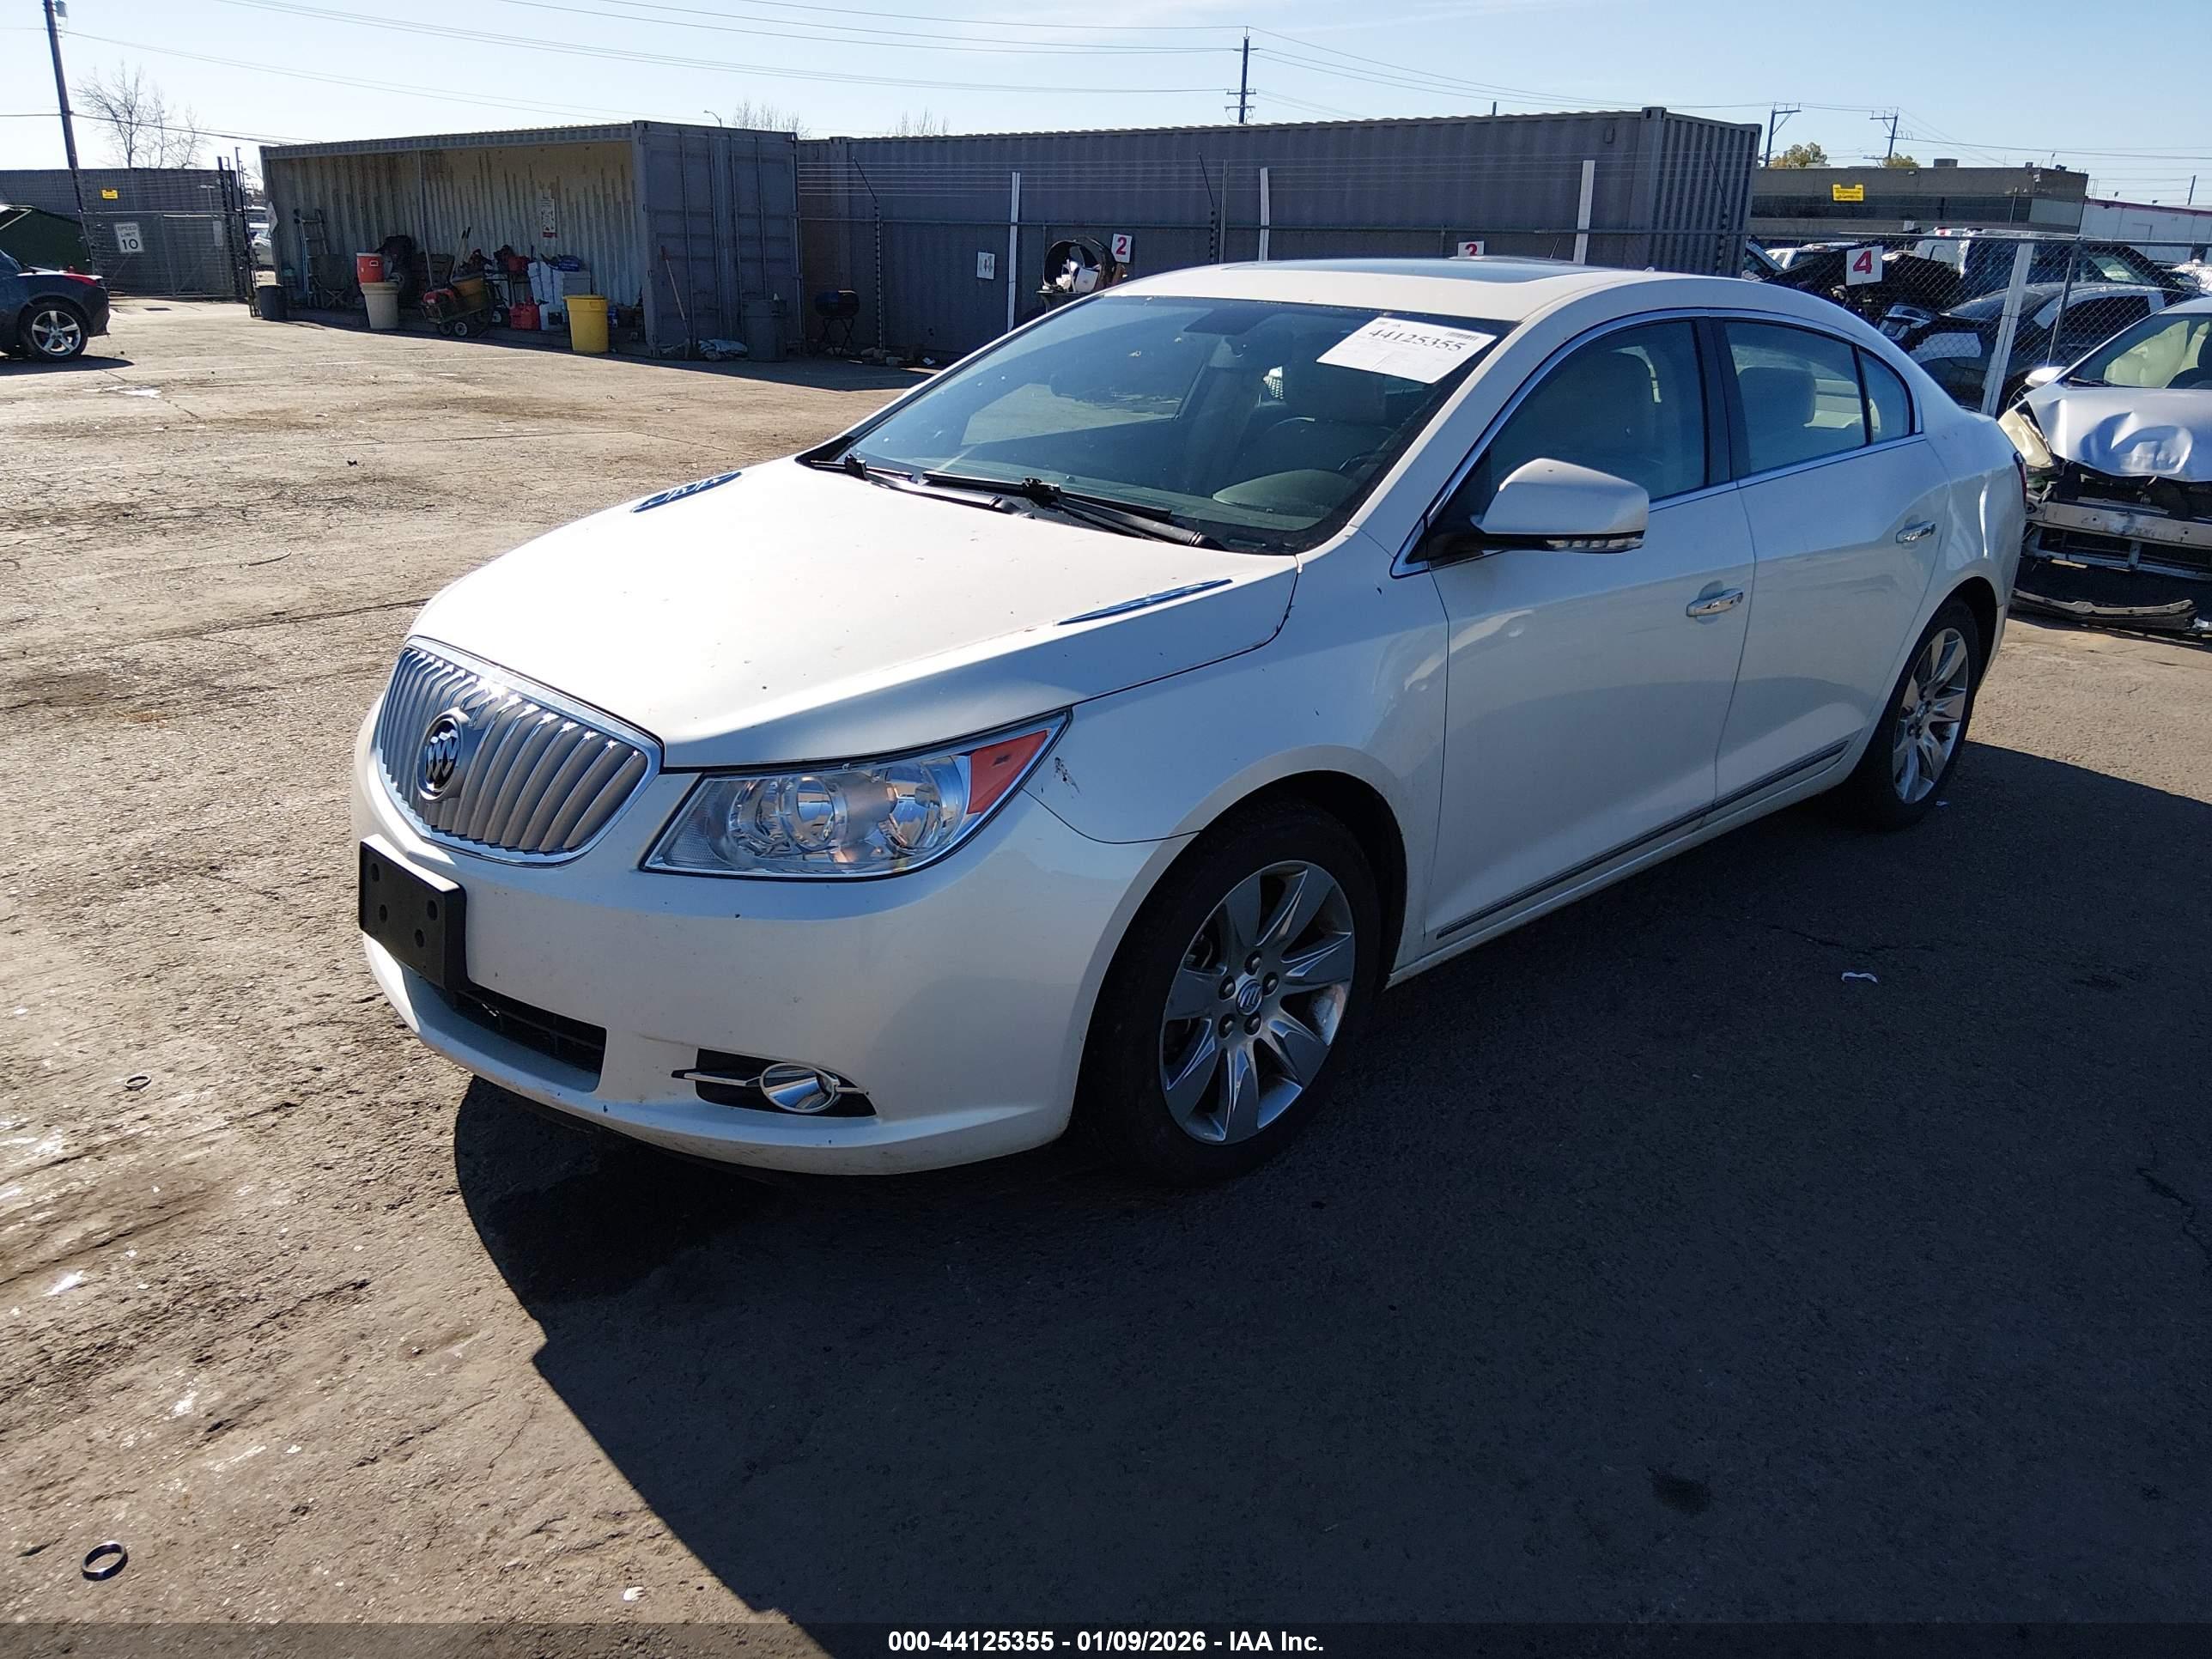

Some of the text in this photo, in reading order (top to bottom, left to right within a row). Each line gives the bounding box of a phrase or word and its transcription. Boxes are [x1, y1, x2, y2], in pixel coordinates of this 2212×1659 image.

[122, 239, 138, 249] 10
[1115, 236, 1127, 256] 2
[1852, 250, 1872, 275] 4
[1369, 329, 1467, 352] 44125355
